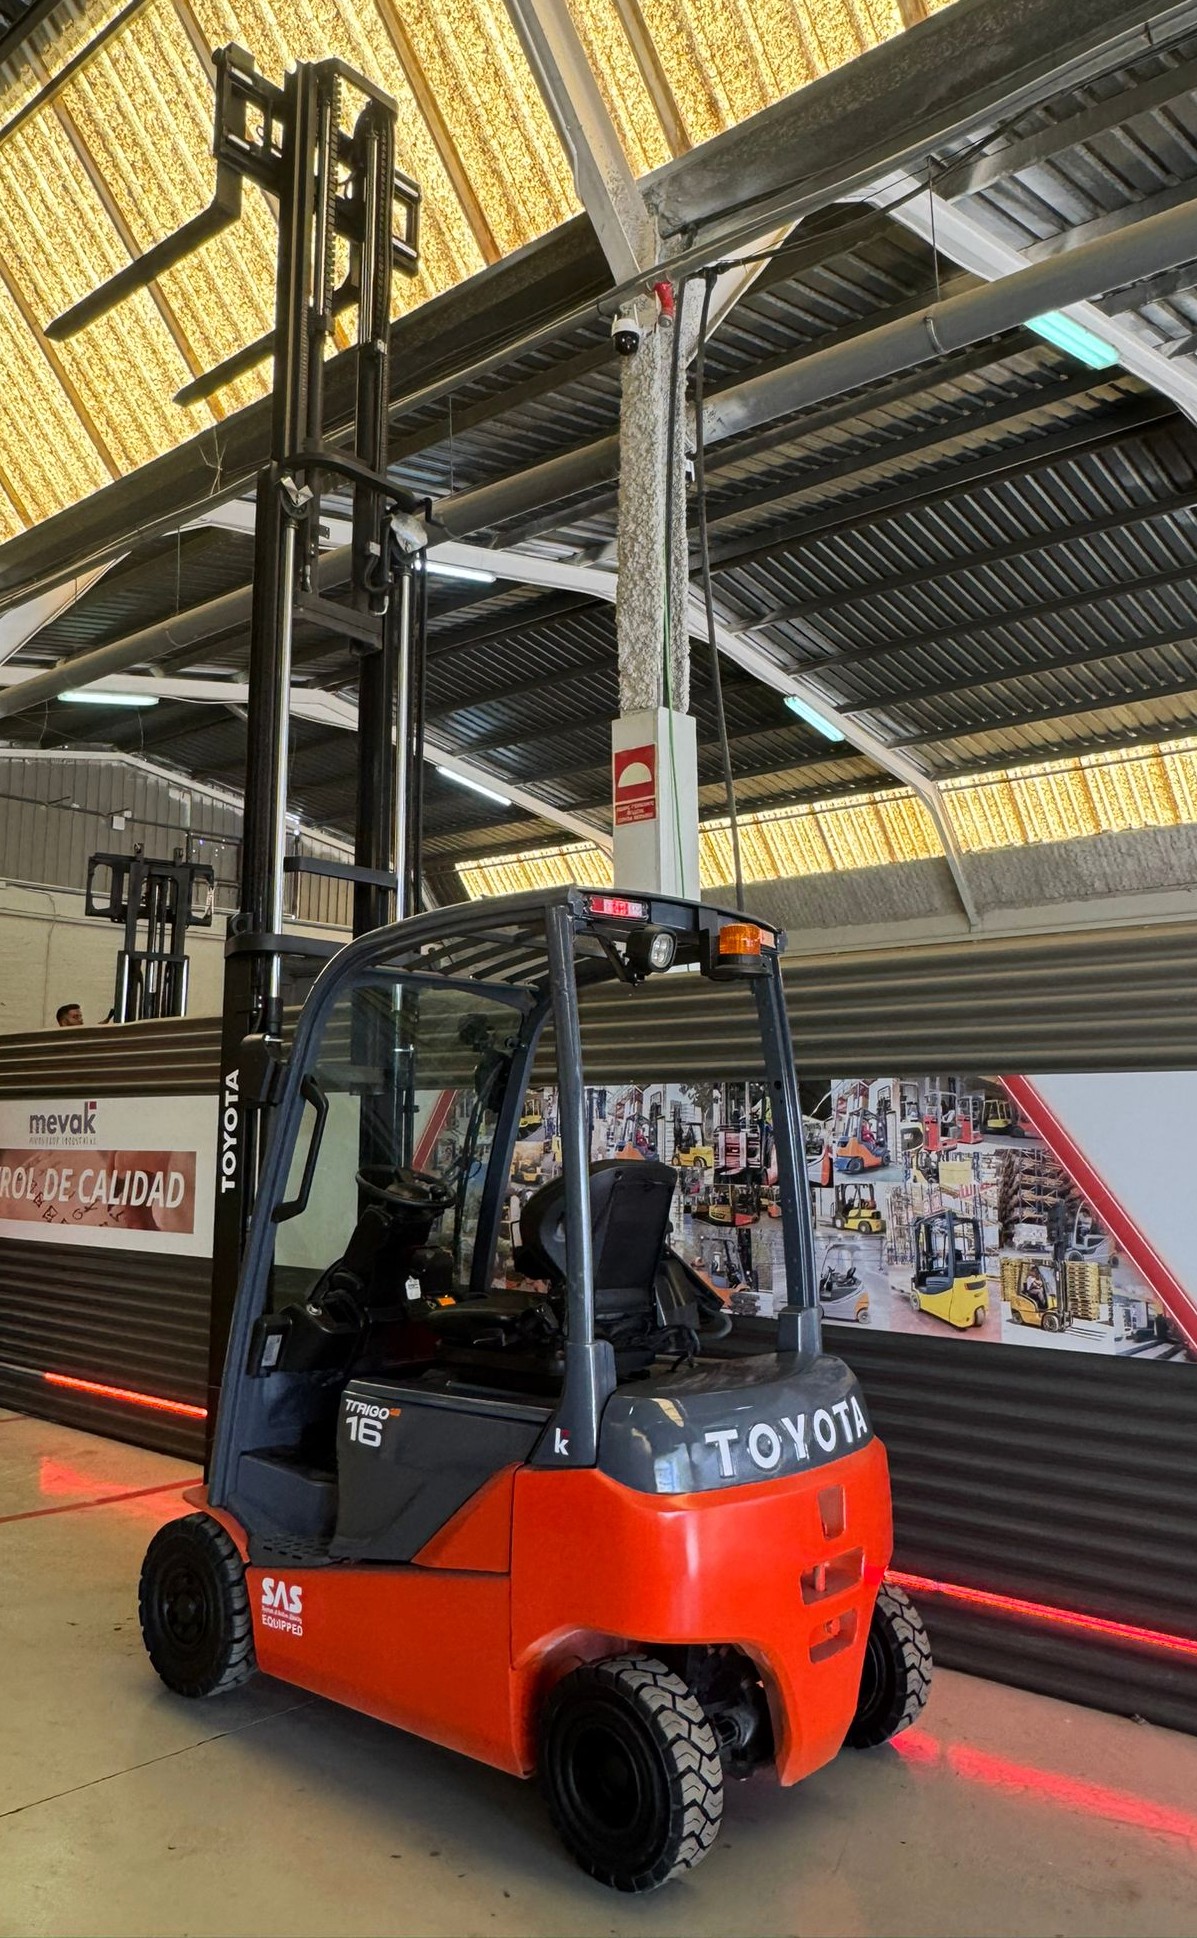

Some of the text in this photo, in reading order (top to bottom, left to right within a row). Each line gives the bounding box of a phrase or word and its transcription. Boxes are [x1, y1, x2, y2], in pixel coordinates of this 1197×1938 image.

[29, 1101, 97, 1134] mevak
[221, 1069, 239, 1193] TOYOTA
[0, 1166, 185, 1209] ROL DE CALIDAD
[345, 1416, 383, 1447] 16
[704, 1395, 868, 1477] TOYOTA
[262, 1577, 303, 1613] SAS
[261, 1614, 303, 1636] EQUIPPED
